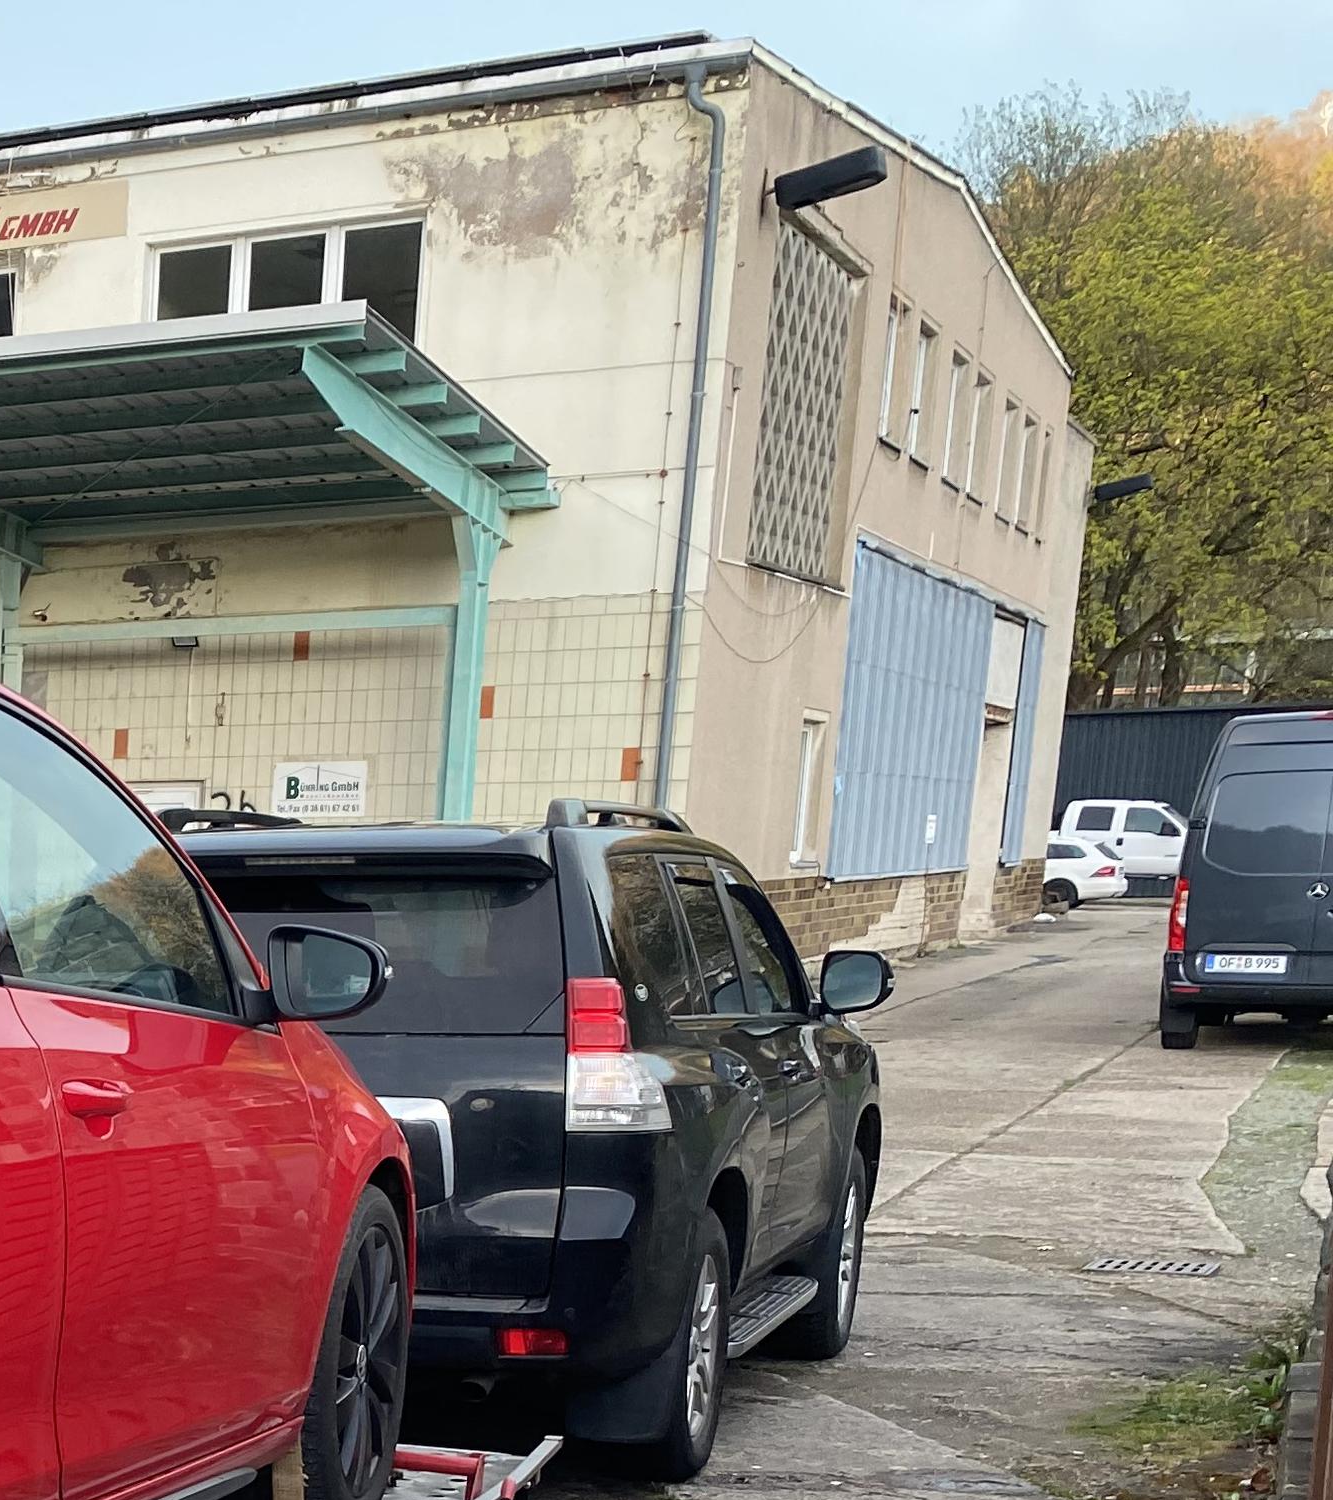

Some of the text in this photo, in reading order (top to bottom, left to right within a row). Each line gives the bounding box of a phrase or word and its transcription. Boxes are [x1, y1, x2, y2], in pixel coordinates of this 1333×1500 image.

[331, 780, 359, 792] GmbH
[1219, 956, 1237, 969] OF
[1256, 957, 1280, 969] 995
